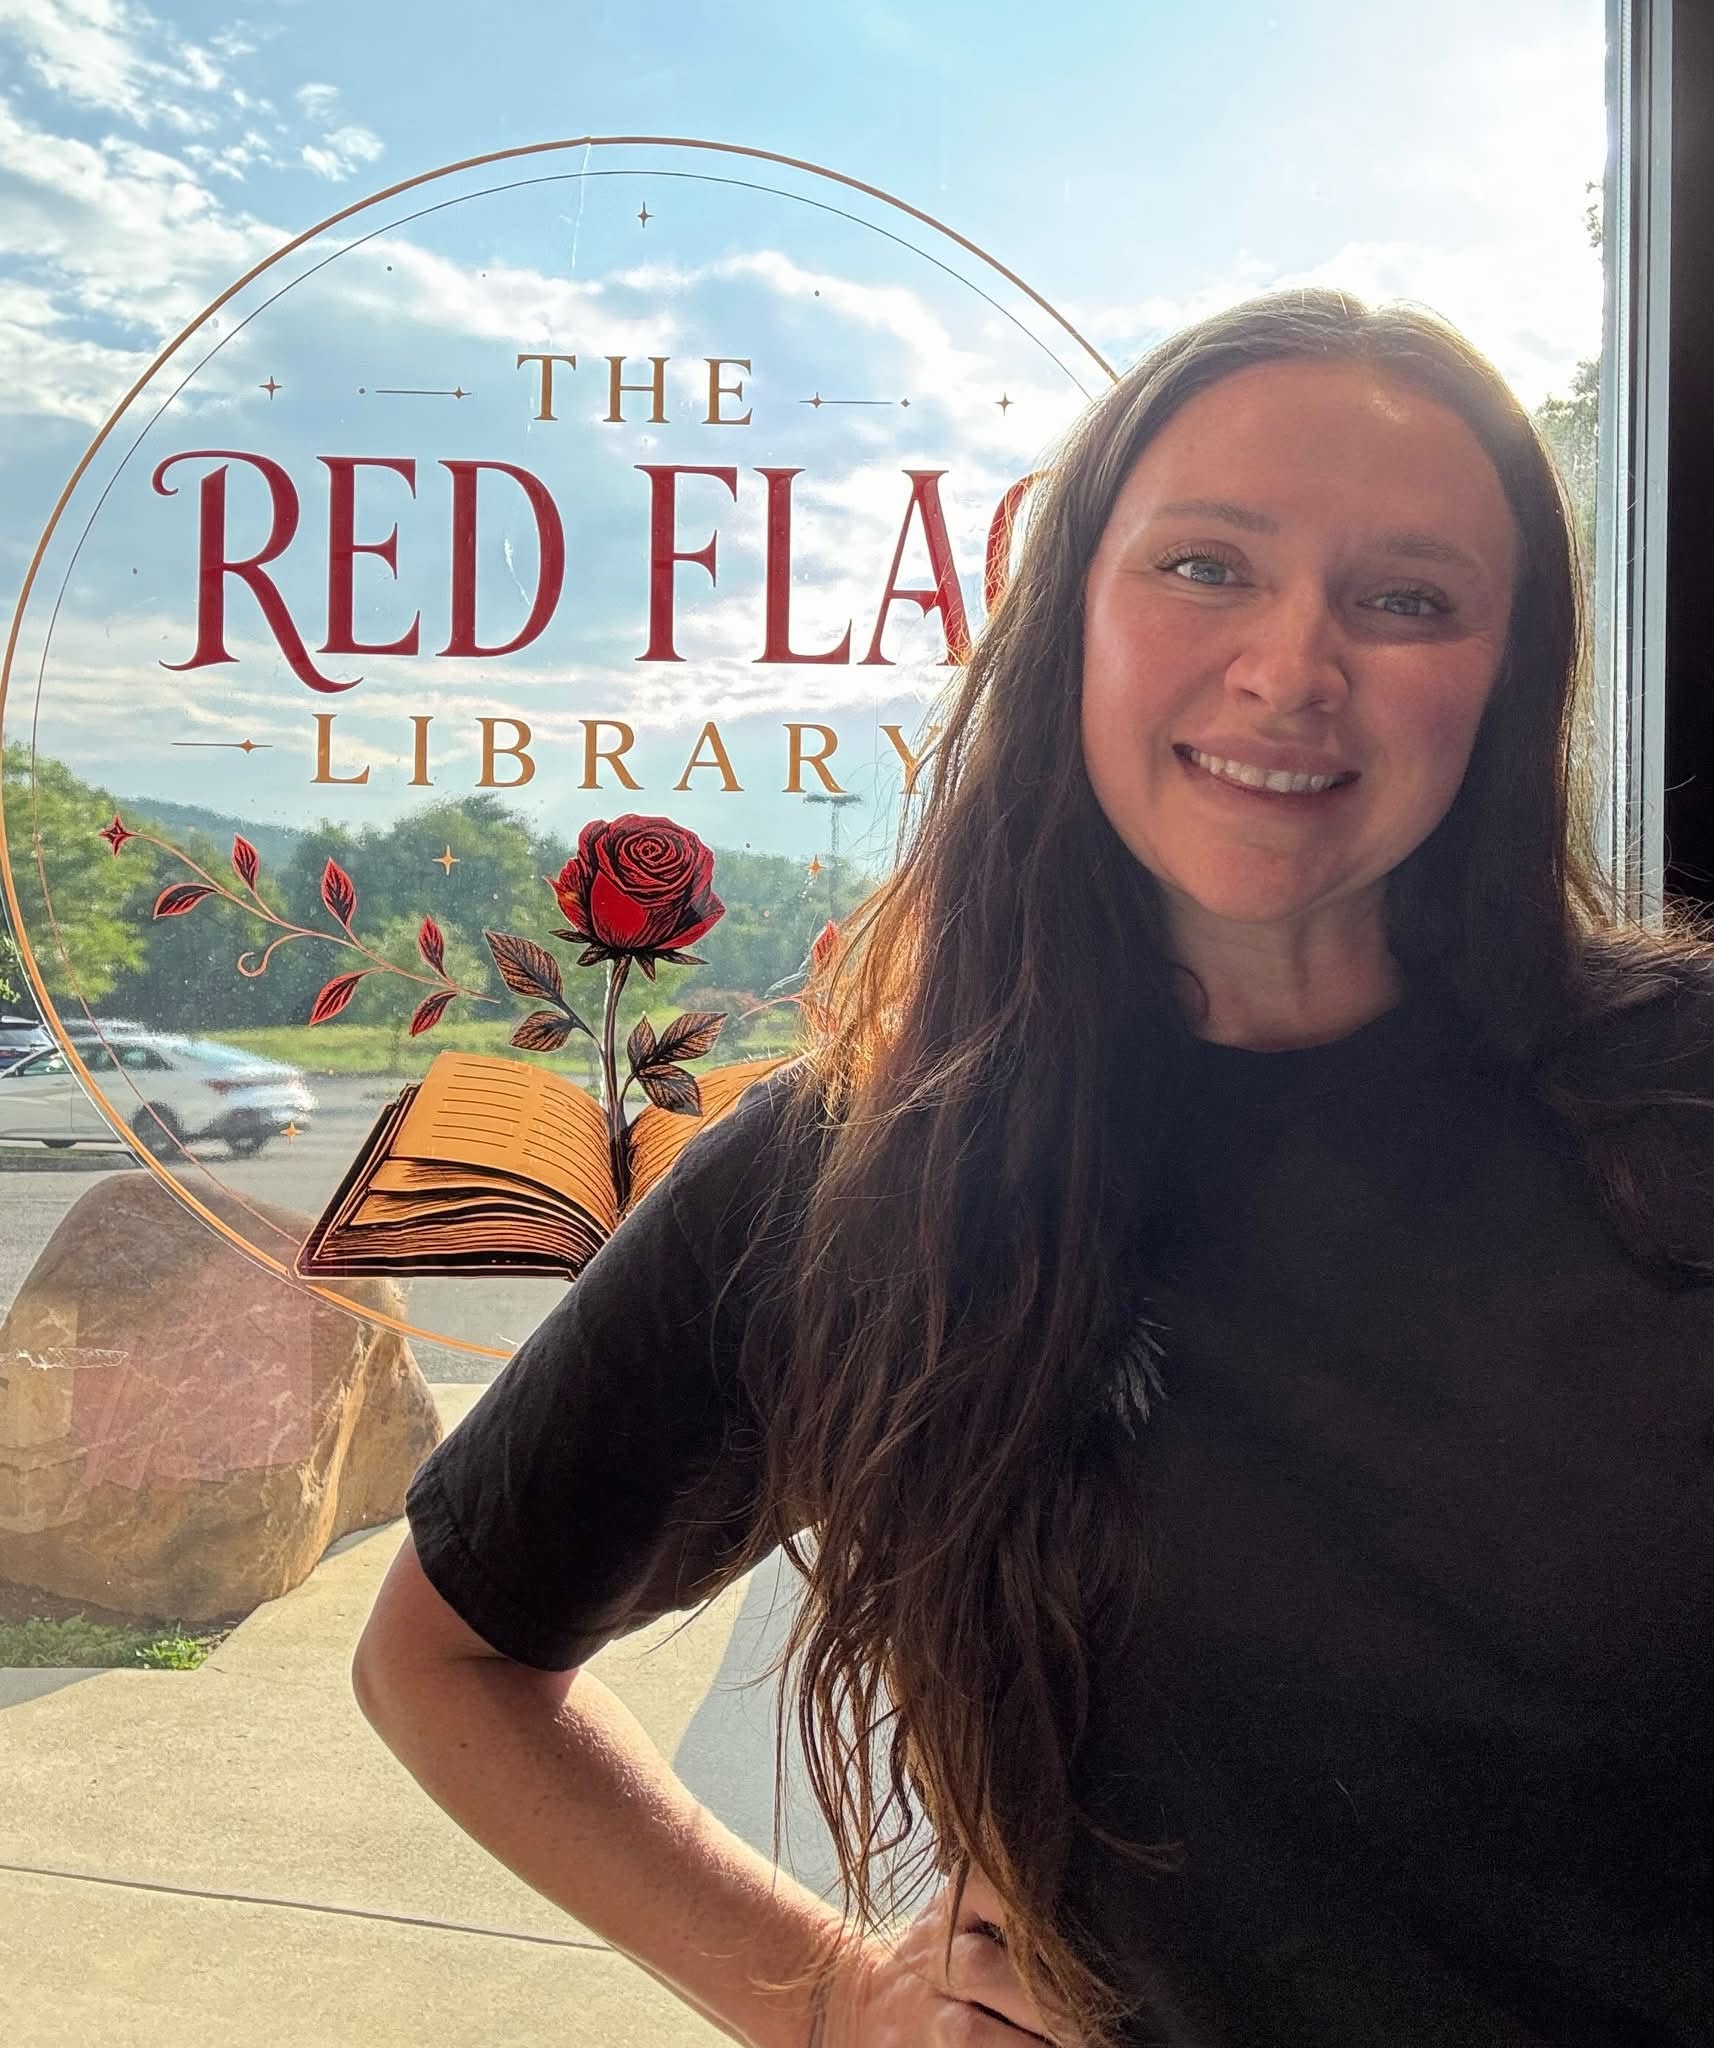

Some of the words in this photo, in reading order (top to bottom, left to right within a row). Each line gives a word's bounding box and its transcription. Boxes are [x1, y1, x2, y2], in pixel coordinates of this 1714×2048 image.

[517, 354, 753, 425] THE
[151, 450, 565, 693] RED
[312, 713, 942, 795] LIBRARY
